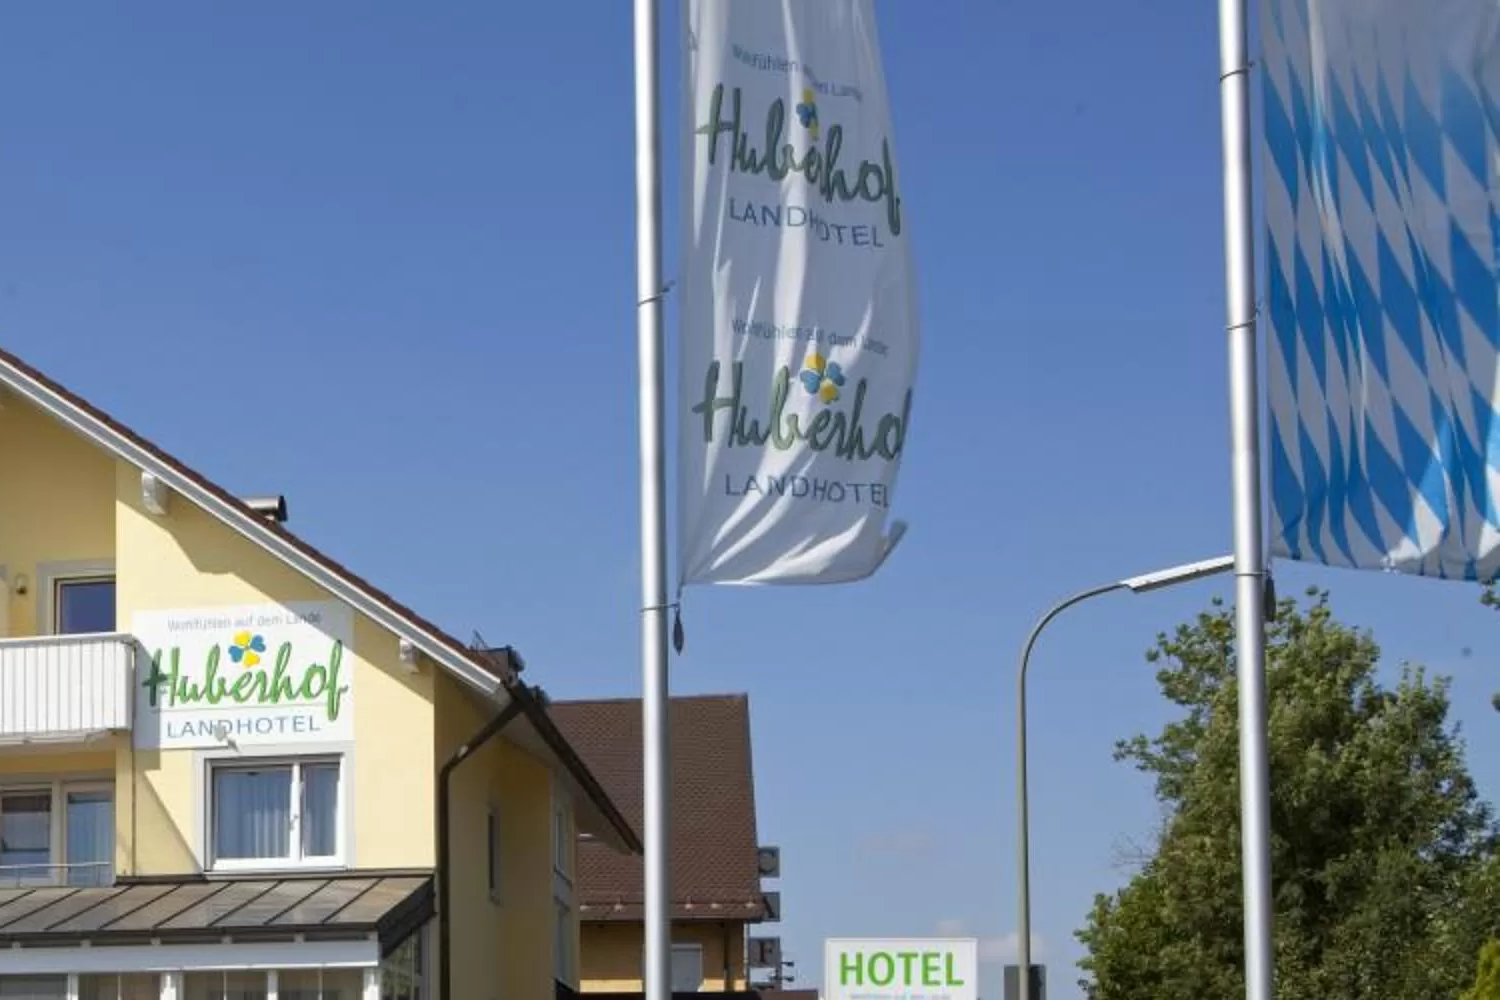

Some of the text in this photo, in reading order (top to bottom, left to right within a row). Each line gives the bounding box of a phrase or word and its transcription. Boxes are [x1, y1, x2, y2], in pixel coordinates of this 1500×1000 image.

[729, 197, 884, 248] LANDHOTEL
[724, 474, 889, 508] LANDHOTEL
[142, 639, 349, 721] Huberhof
[167, 715, 321, 738] LANDHOTEL
[839, 951, 965, 987] HOTEL
